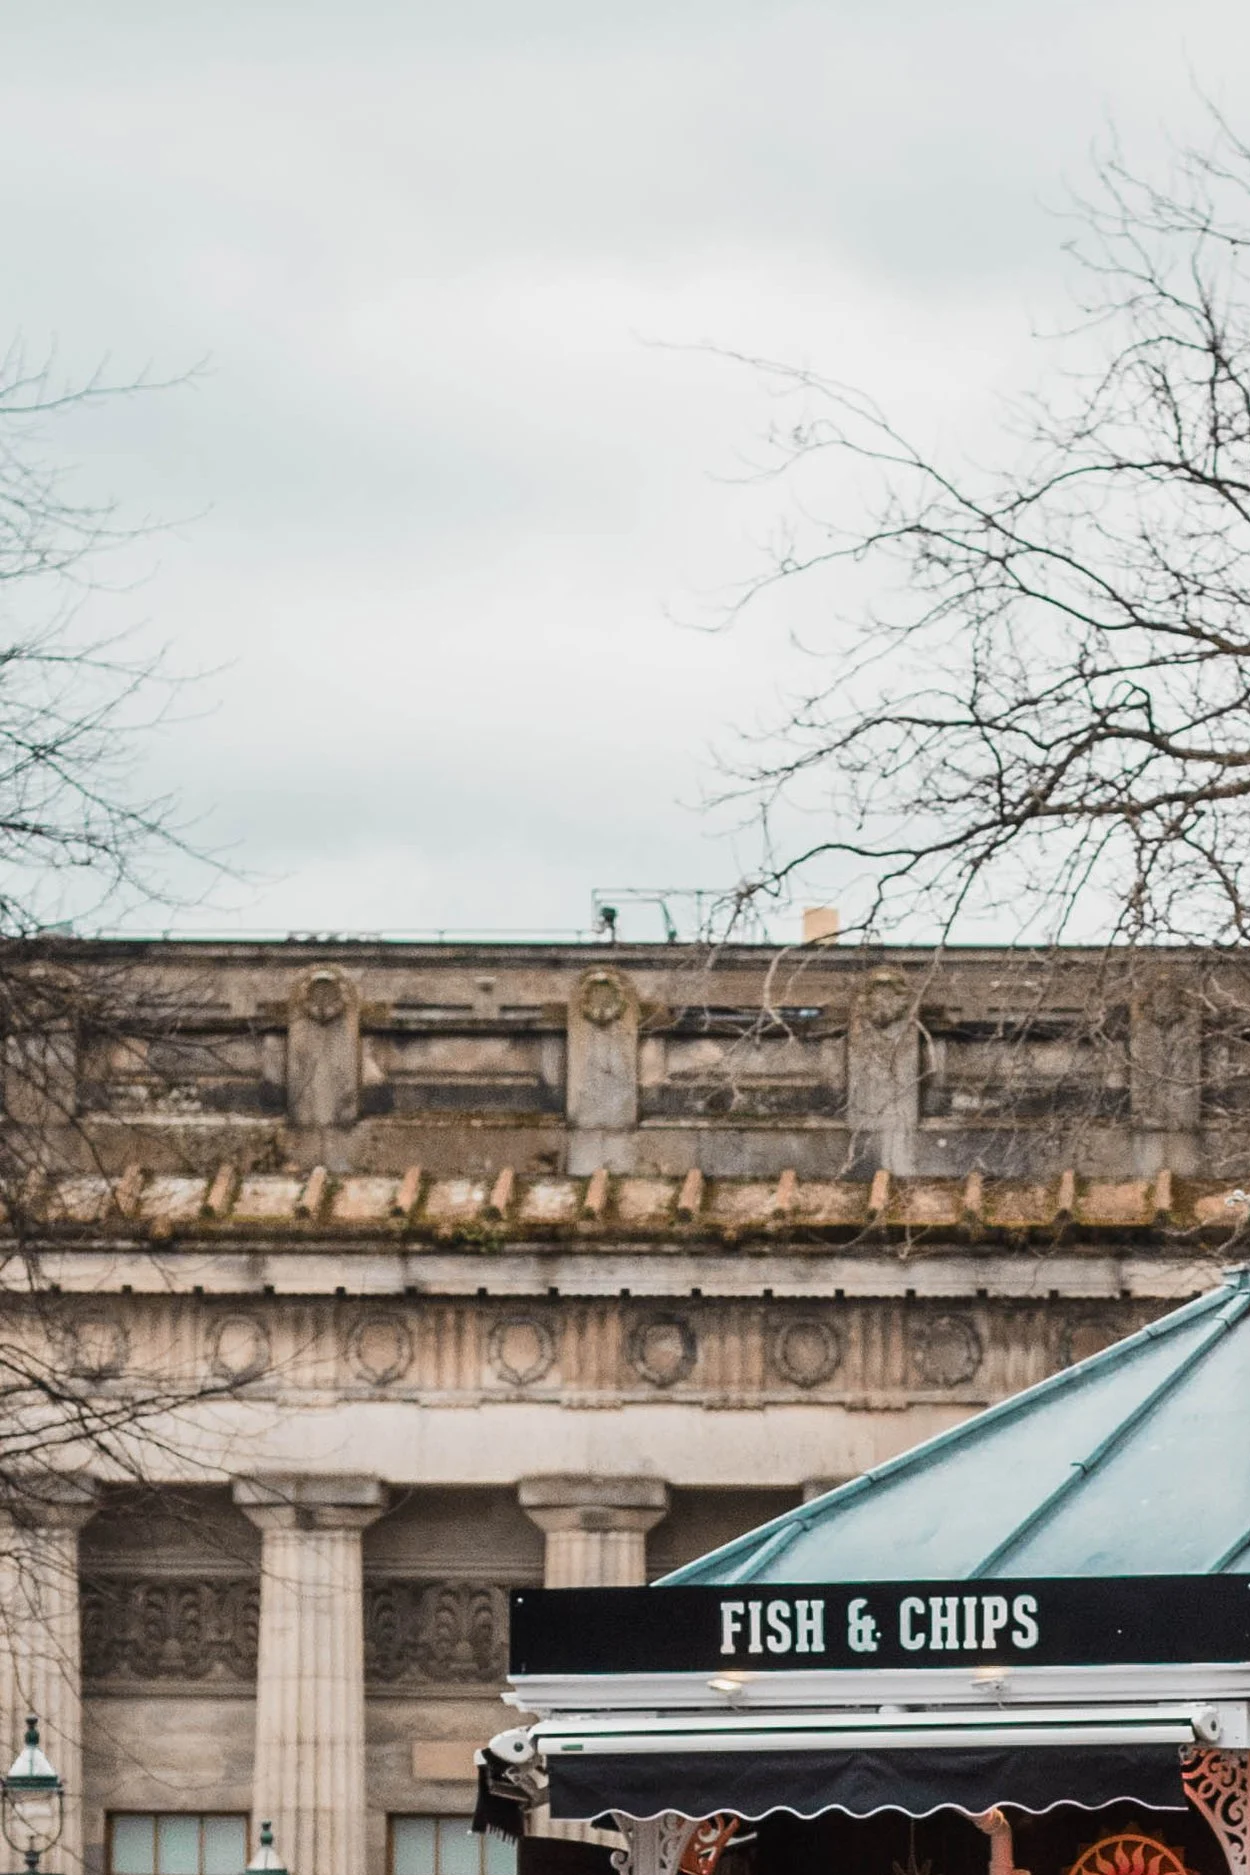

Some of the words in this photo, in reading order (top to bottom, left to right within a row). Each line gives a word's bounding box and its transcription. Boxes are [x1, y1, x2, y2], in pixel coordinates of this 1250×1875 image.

[720, 1600, 826, 1654] FISH
[847, 1598, 879, 1653] &
[899, 1595, 1039, 1651] CHIPS
